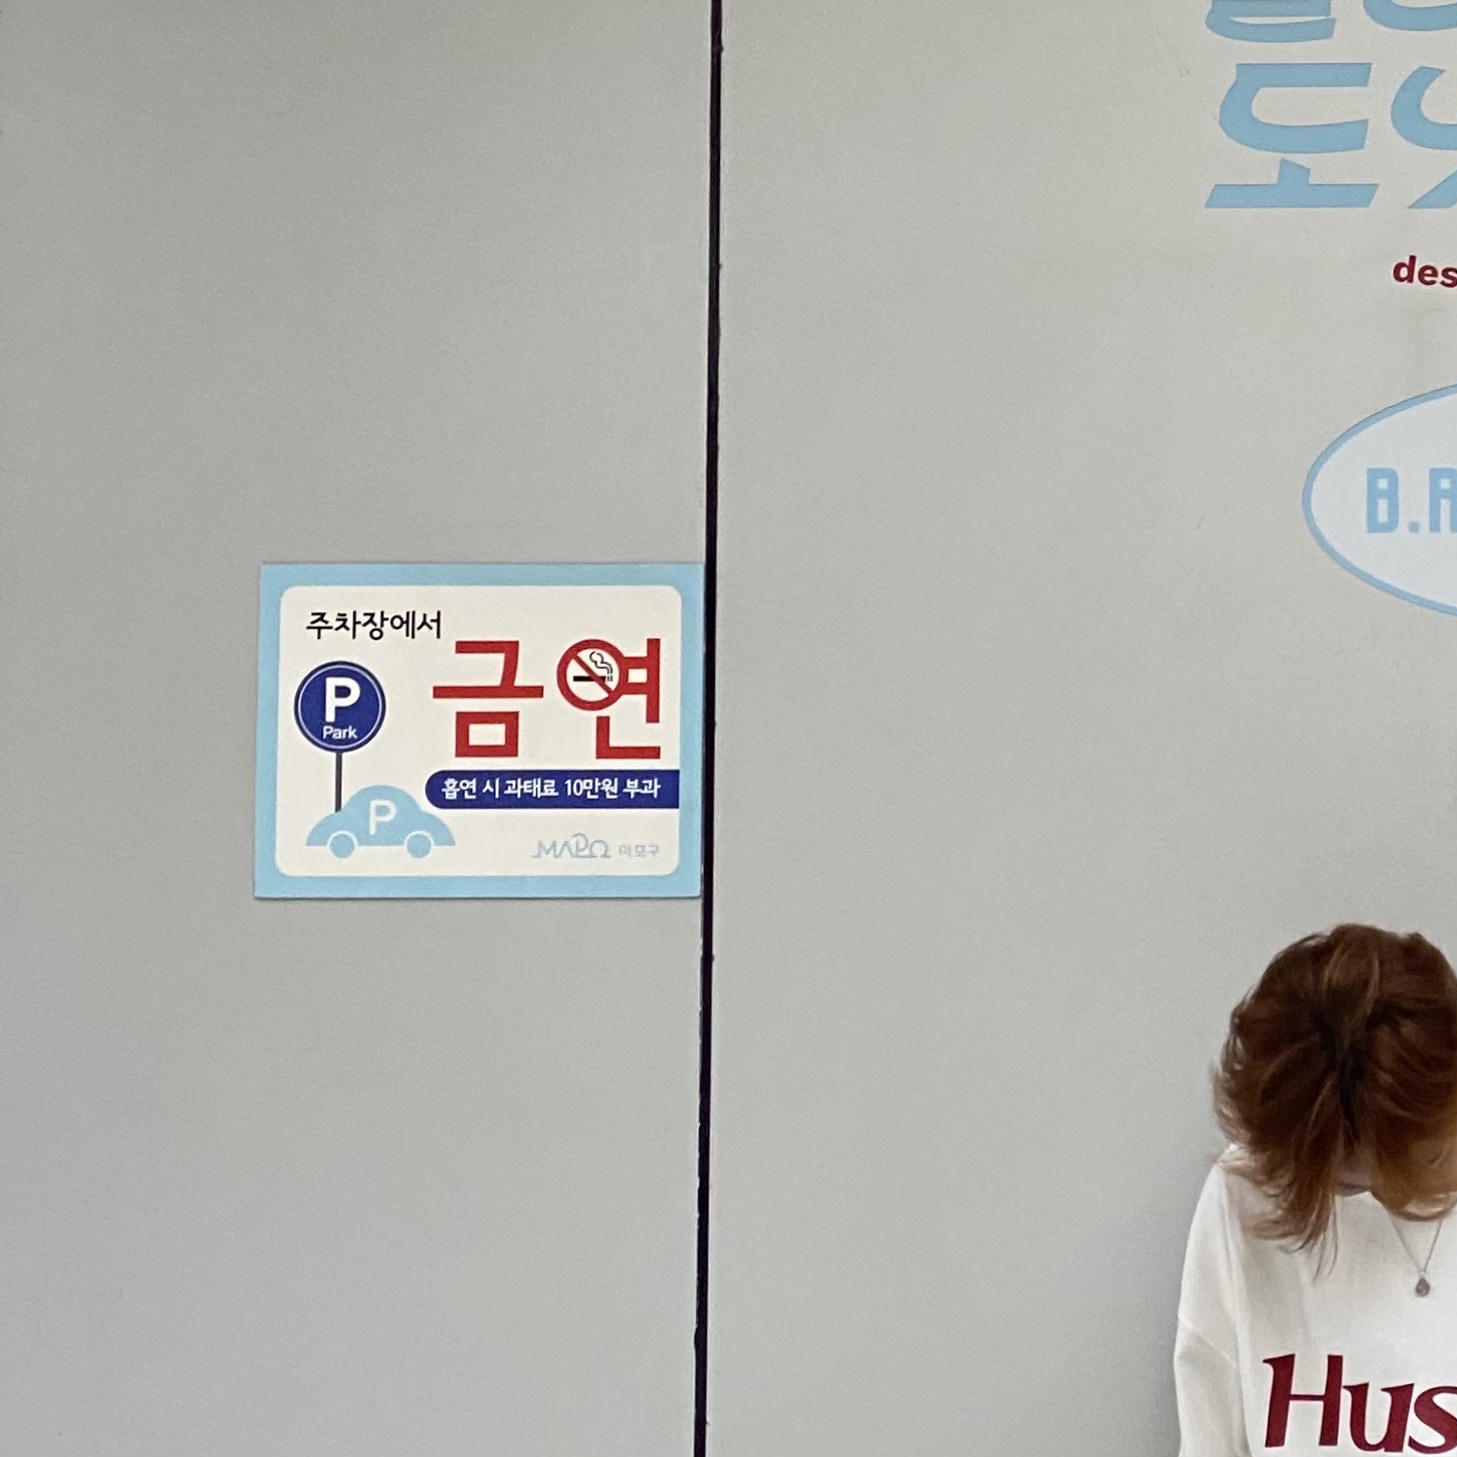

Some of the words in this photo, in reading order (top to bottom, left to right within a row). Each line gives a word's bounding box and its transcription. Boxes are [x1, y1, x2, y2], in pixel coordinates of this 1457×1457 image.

[306, 610, 442, 641] 주차장에서
[325, 677, 361, 723] P
[432, 638, 661, 760] 금연
[322, 726, 358, 740] Park
[441, 778, 477, 799] 흡연
[482, 778, 500, 799] 시
[504, 778, 559, 799] 과태료
[565, 778, 618, 799] 10만원
[623, 778, 661, 799] 부과
[368, 800, 397, 836] P
